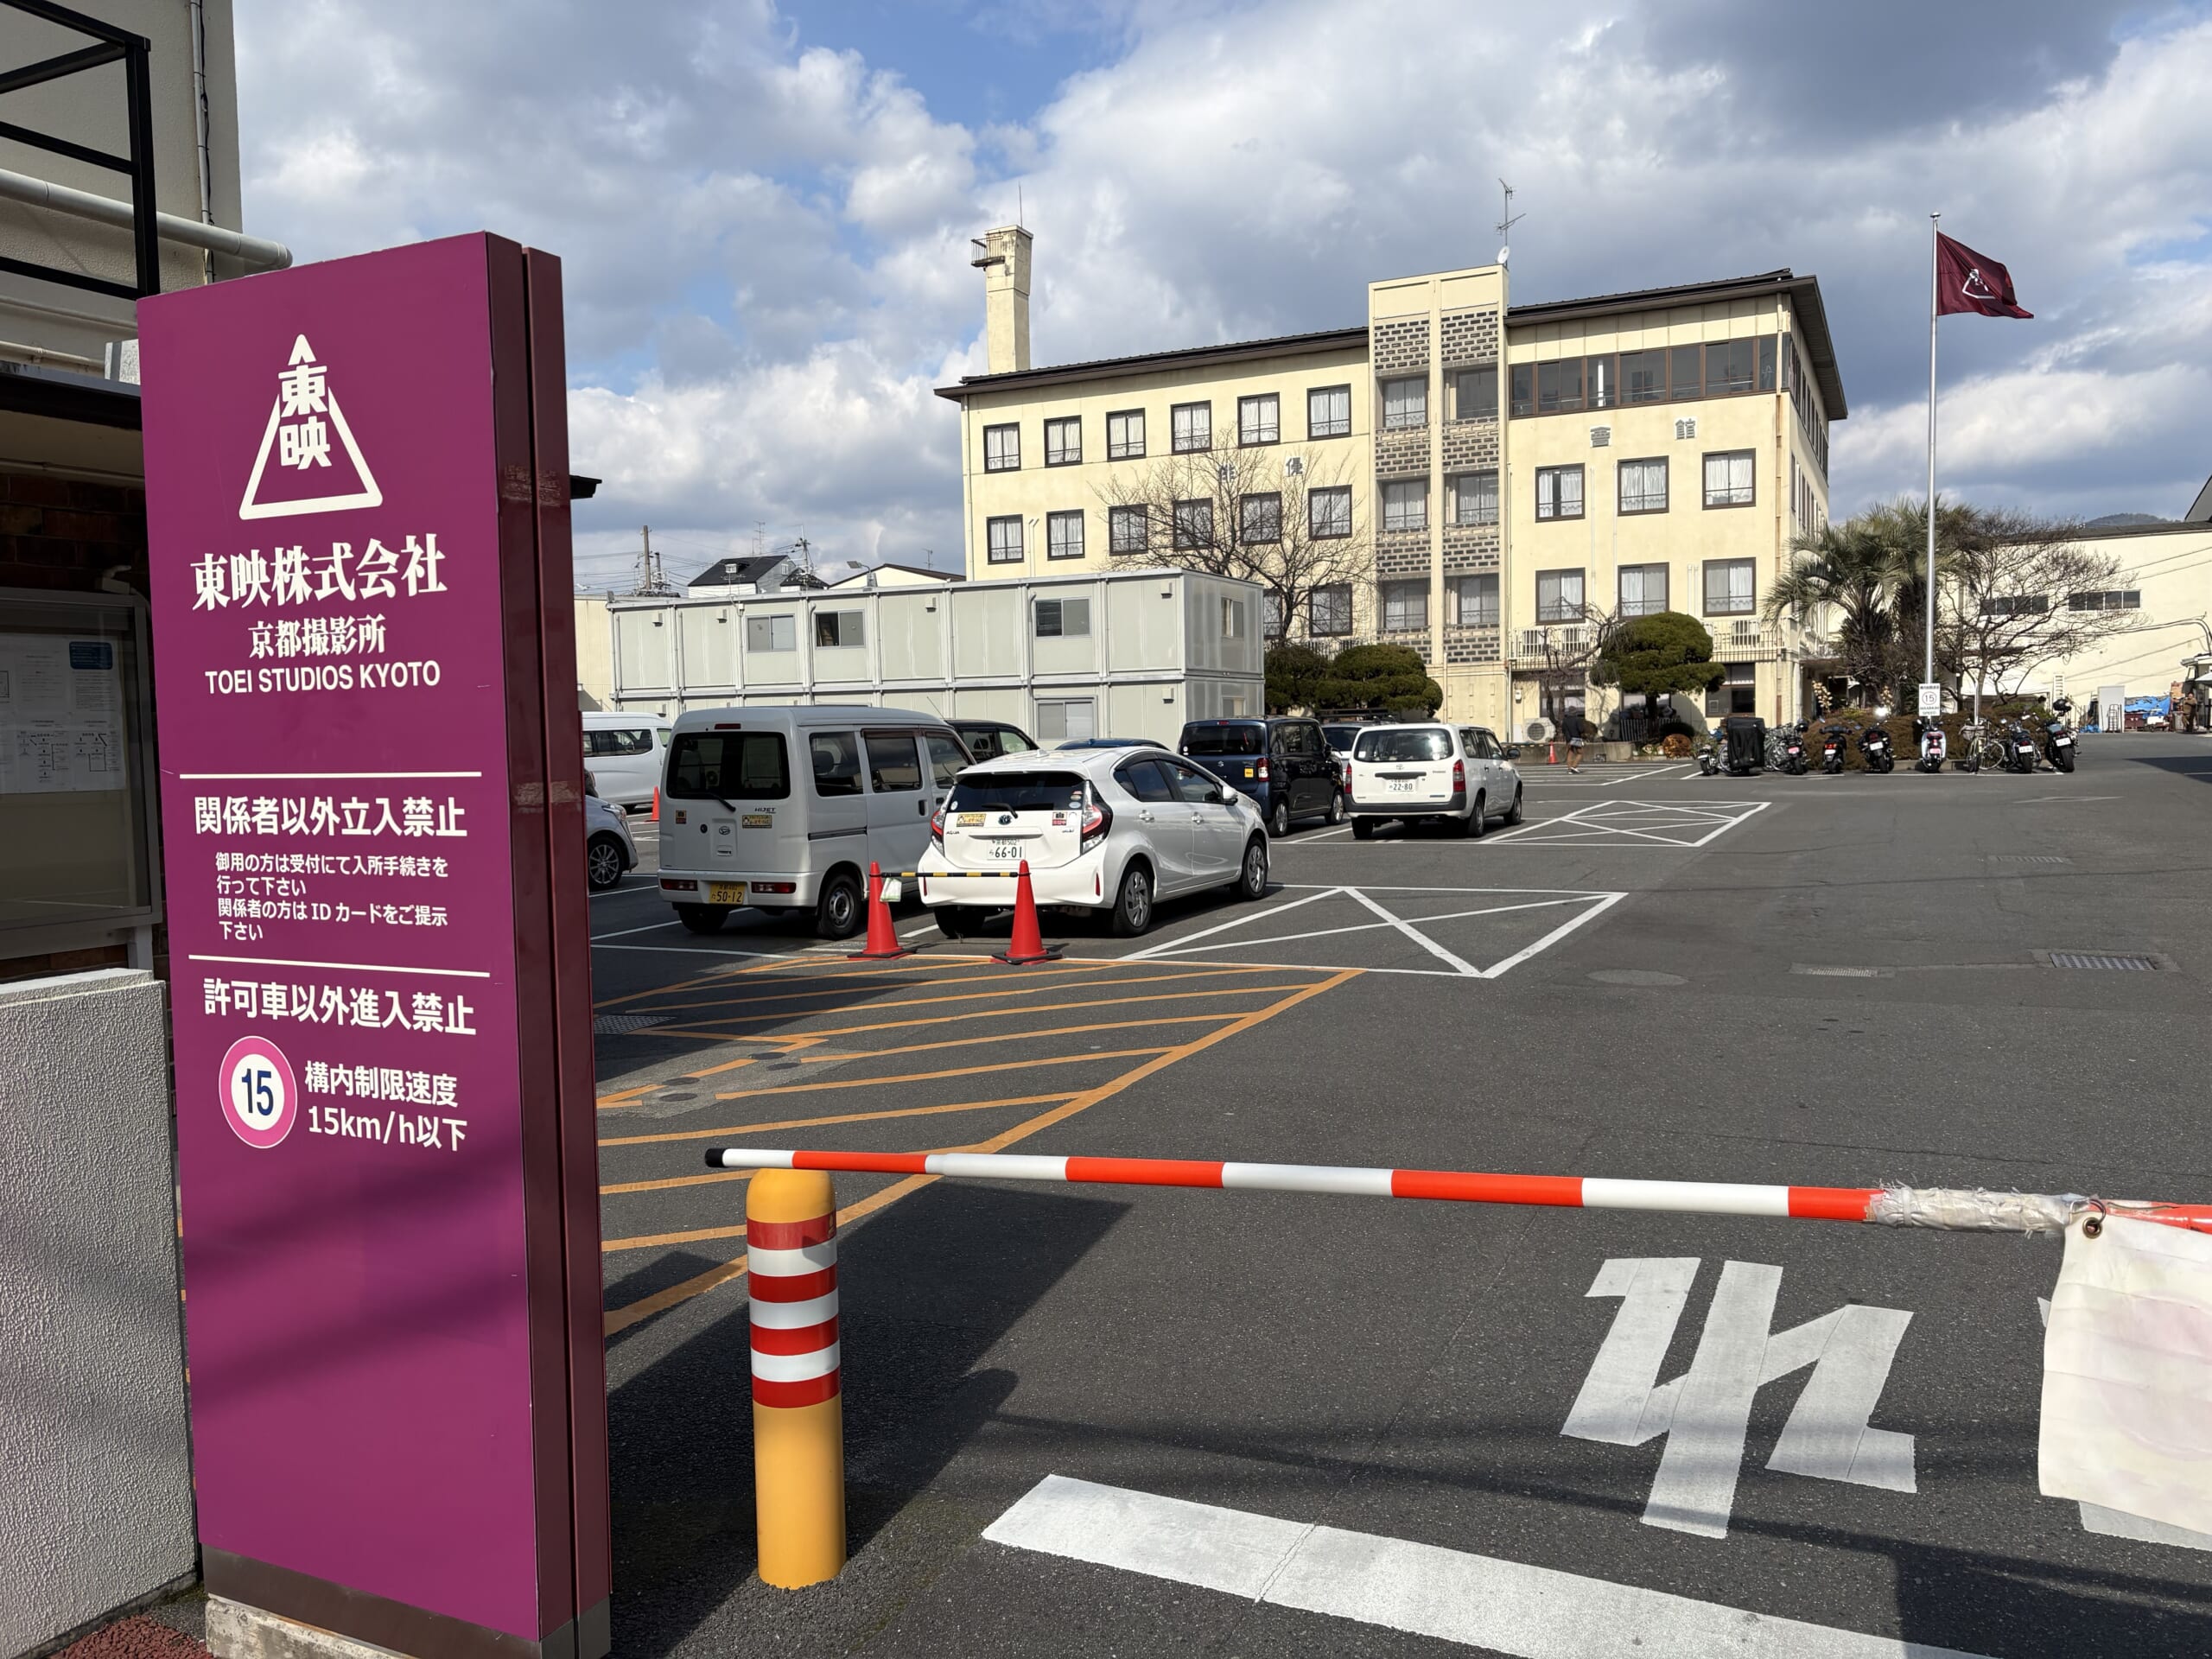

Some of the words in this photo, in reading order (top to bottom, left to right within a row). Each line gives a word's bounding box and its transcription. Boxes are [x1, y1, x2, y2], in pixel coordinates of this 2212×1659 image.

[278, 365, 332, 469] 東映
[190, 533, 448, 611] 東映株式会社
[249, 613, 386, 659] 京都撮影所
[205, 670, 252, 694] TOEI
[258, 664, 353, 692] STUDIOS
[359, 660, 441, 688] KYOTO
[194, 796, 467, 837] 関係者以外立入禁止
[215, 852, 448, 878] 御用の方は受付にて入所手続きを
[216, 875, 307, 897] 行って下さい
[219, 921, 264, 941] 下さい
[203, 978, 476, 1035] 許可車以外進入禁止
[242, 1068, 274, 1116] 15
[305, 1060, 458, 1108] 構内制限速度
[308, 1106, 467, 1151] 15km/h以下
